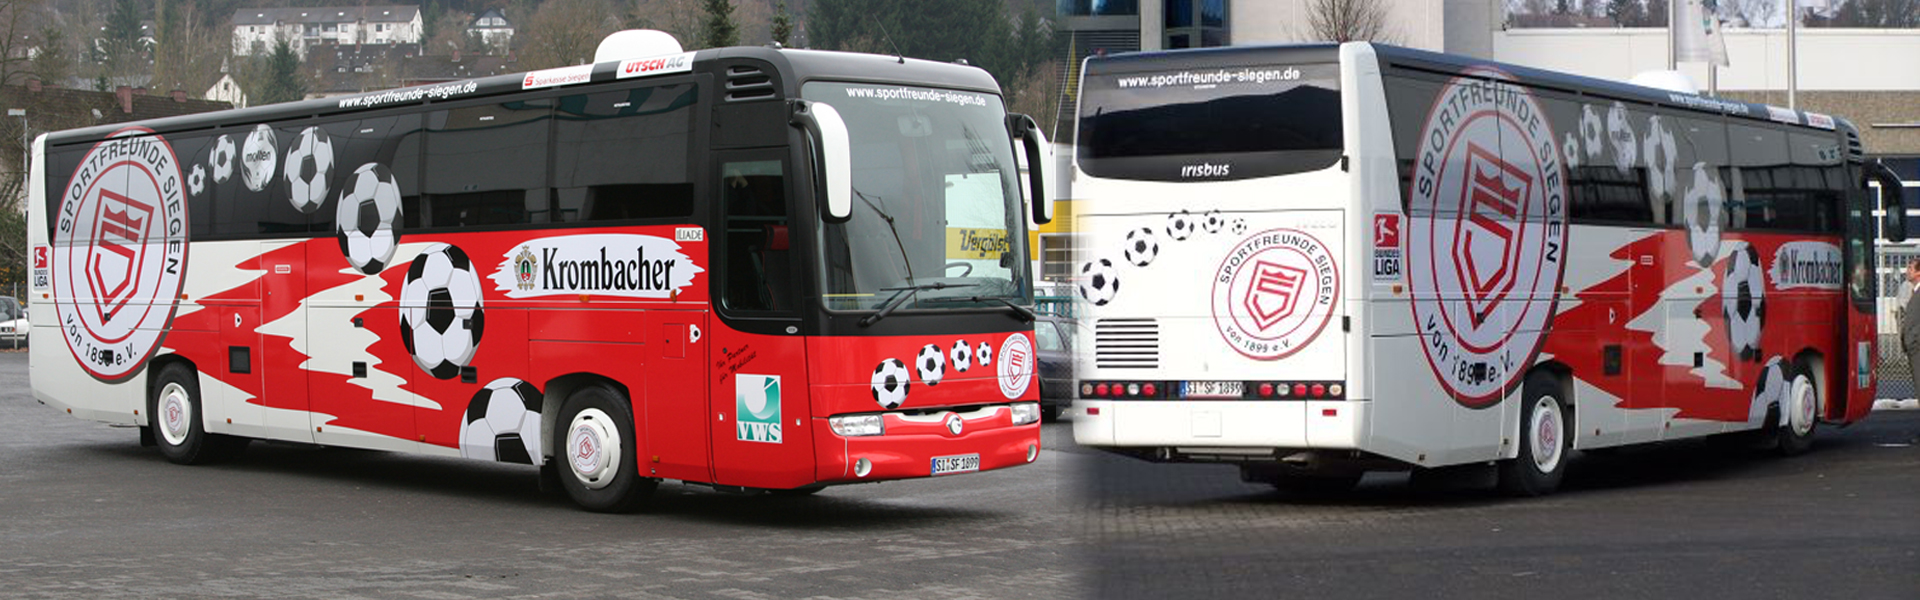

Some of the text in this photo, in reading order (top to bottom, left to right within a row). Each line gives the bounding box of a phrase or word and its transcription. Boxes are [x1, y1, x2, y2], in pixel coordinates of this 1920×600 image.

[625, 56, 685, 73] UTSCH AG
[535, 75, 567, 86] Sparkasse
[568, 73, 589, 83] Siegen
[1118, 66, 1300, 89] www.sportfreunde-siegen.de
[339, 80, 477, 107] www.sportfreunde-siegen.de
[846, 87, 986, 106] www.sportfreunde-siegen.de
[1181, 163, 1230, 178] irisbus
[1419, 79, 1561, 263] SPORTFREUNDE SIEGEN
[61, 136, 182, 275] SPORTFREUNDE SIEGEN
[676, 229, 702, 241] ILIADE
[542, 245, 675, 290] Krombacher
[1220, 233, 1332, 305] SPORTFREUNDE SIEGEN
[1375, 258, 1400, 276] LIGA
[1791, 249, 1842, 285] Krombacher
[34, 275, 48, 287] LIGA
[66, 313, 83, 347] von
[1226, 325, 1242, 344] von
[1244, 339, 1269, 354] 1899
[1427, 313, 1448, 362] von
[737, 421, 781, 442] VWS
[936, 456, 979, 471] SI SF 1899
